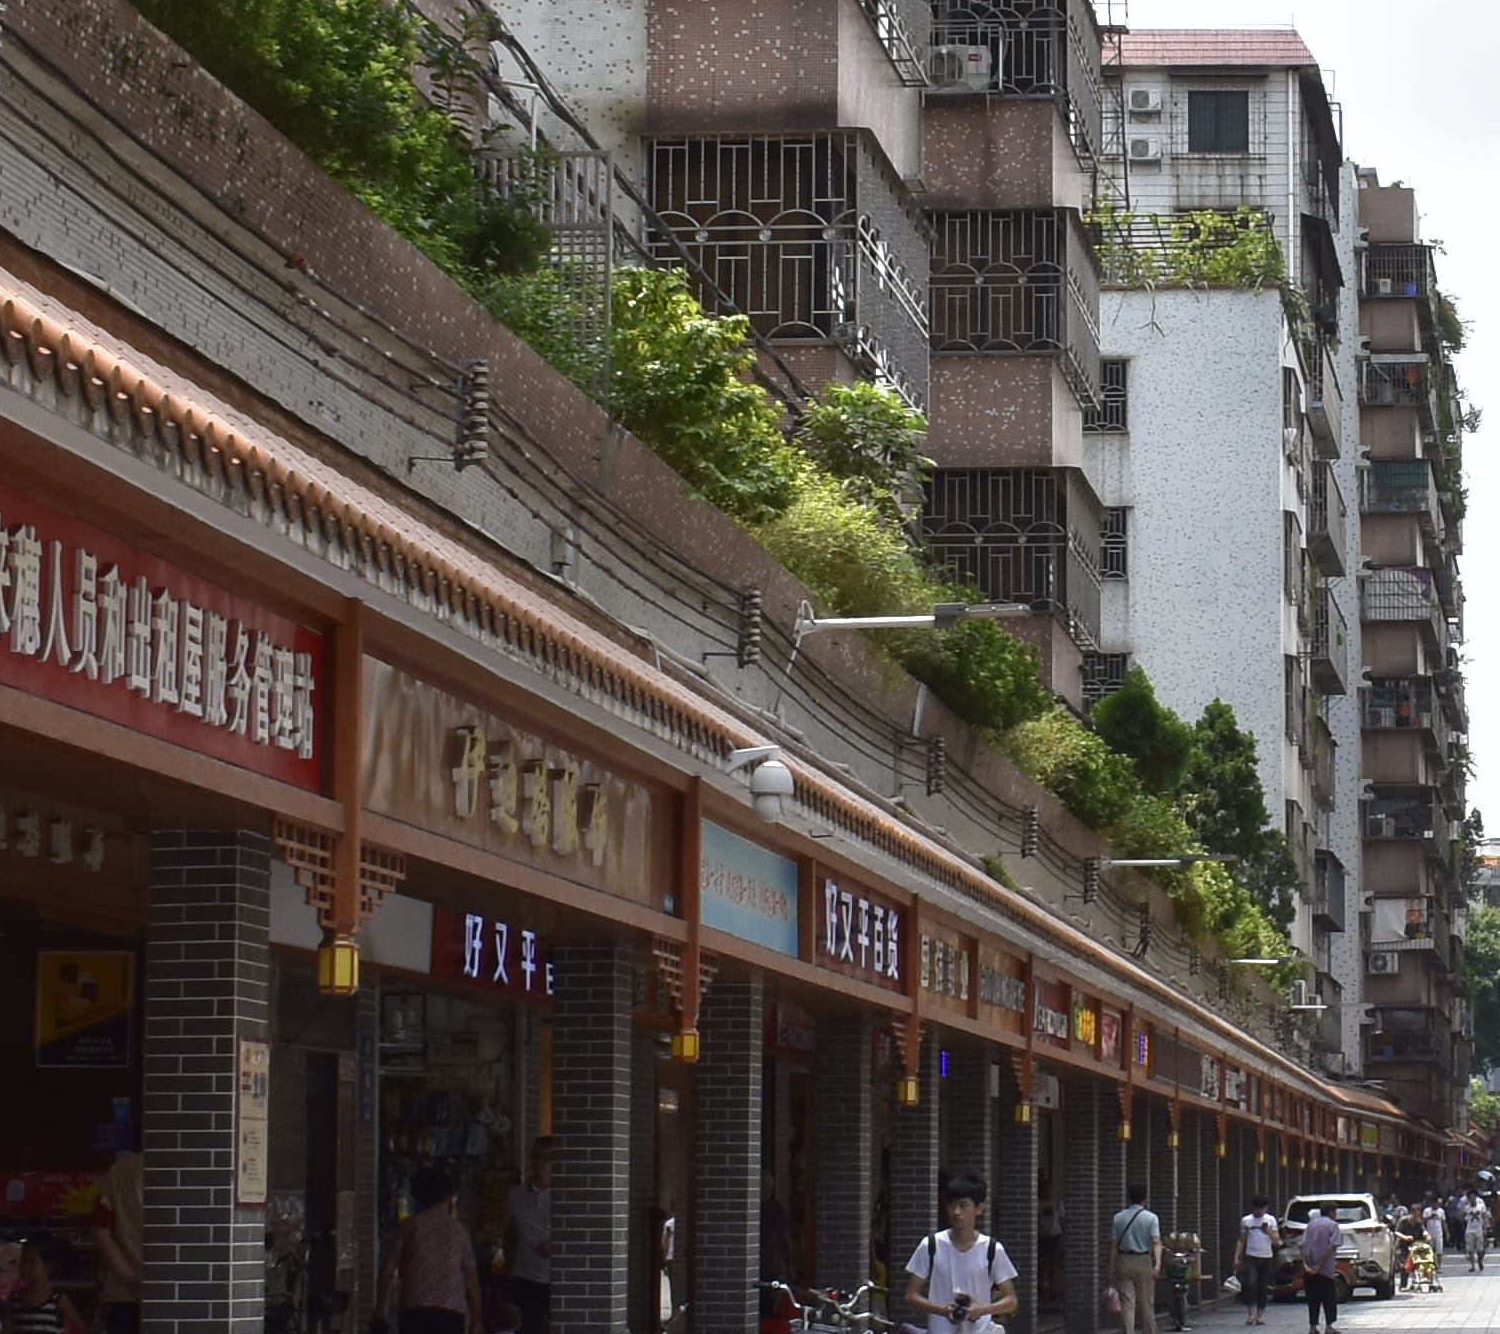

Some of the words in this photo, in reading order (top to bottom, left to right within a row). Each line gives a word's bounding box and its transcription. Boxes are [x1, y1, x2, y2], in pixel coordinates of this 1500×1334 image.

[824, 877, 899, 981] 好又平百货
